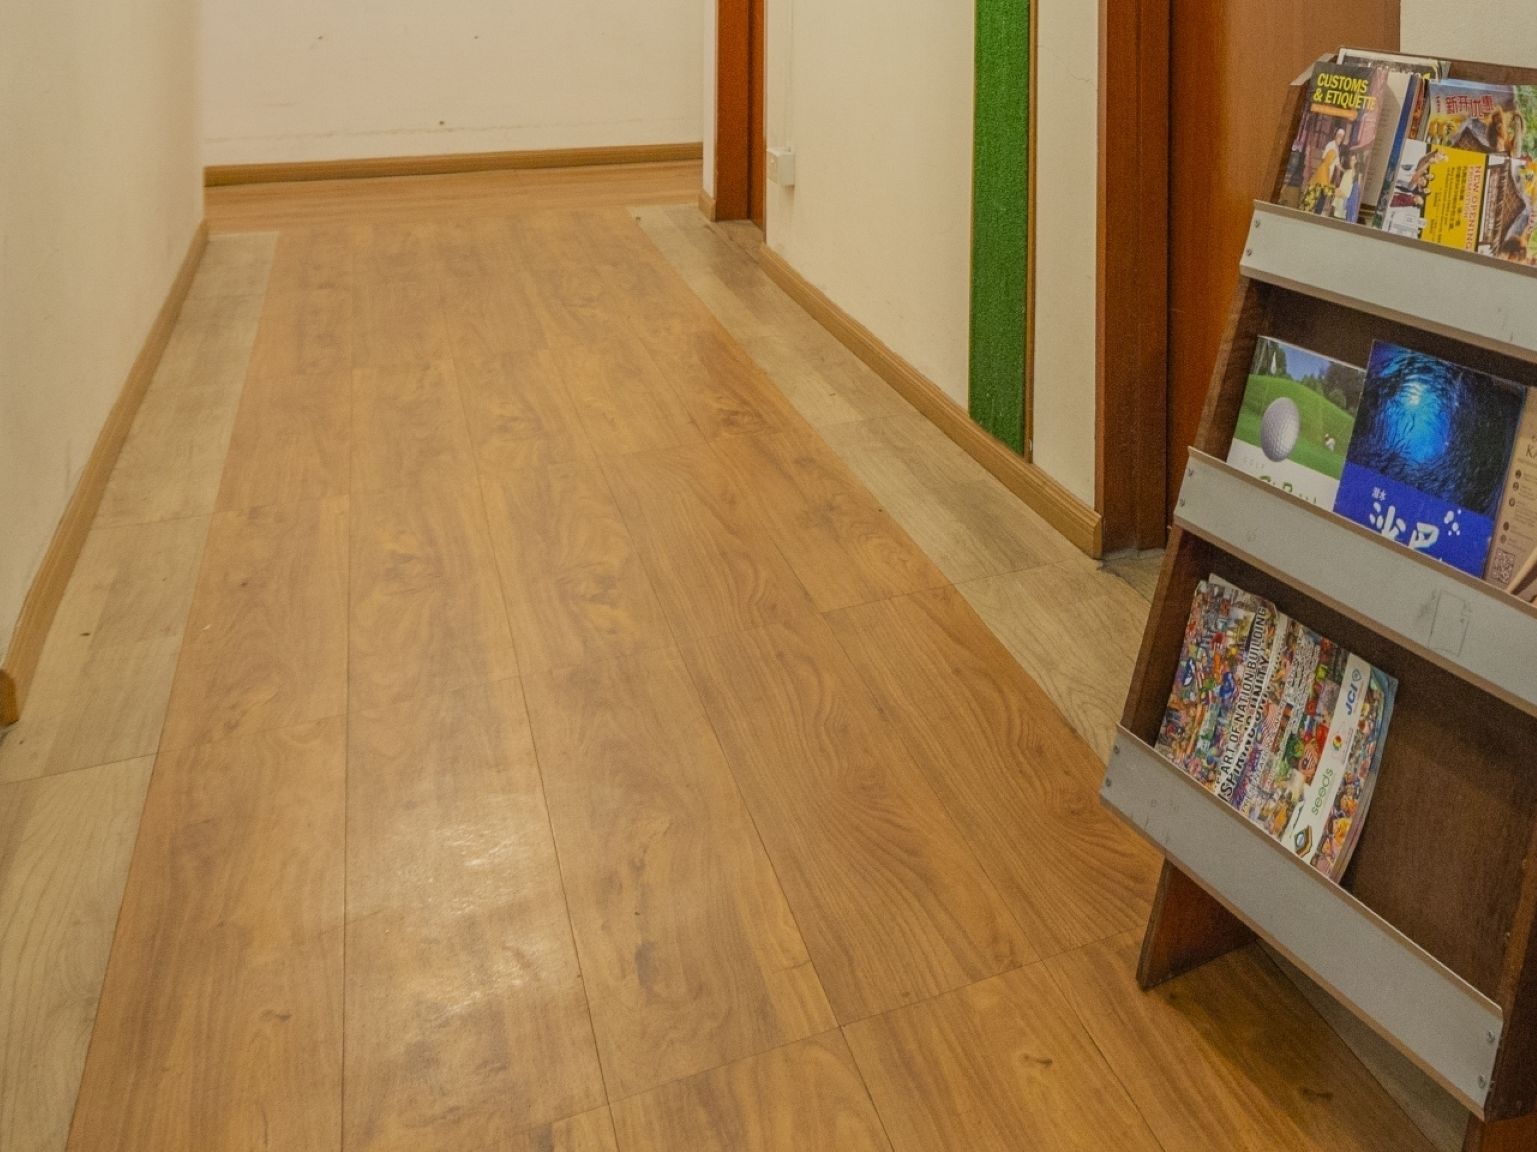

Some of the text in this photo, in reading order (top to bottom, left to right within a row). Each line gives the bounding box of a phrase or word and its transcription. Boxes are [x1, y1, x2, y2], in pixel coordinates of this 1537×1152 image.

[1313, 88, 1323, 102] &
[1317, 72, 1369, 94] CUSTOMS
[1248, 607, 1267, 670] BUILDING
[1345, 682, 1358, 716] JCI
[1311, 767, 1334, 816] seeds
